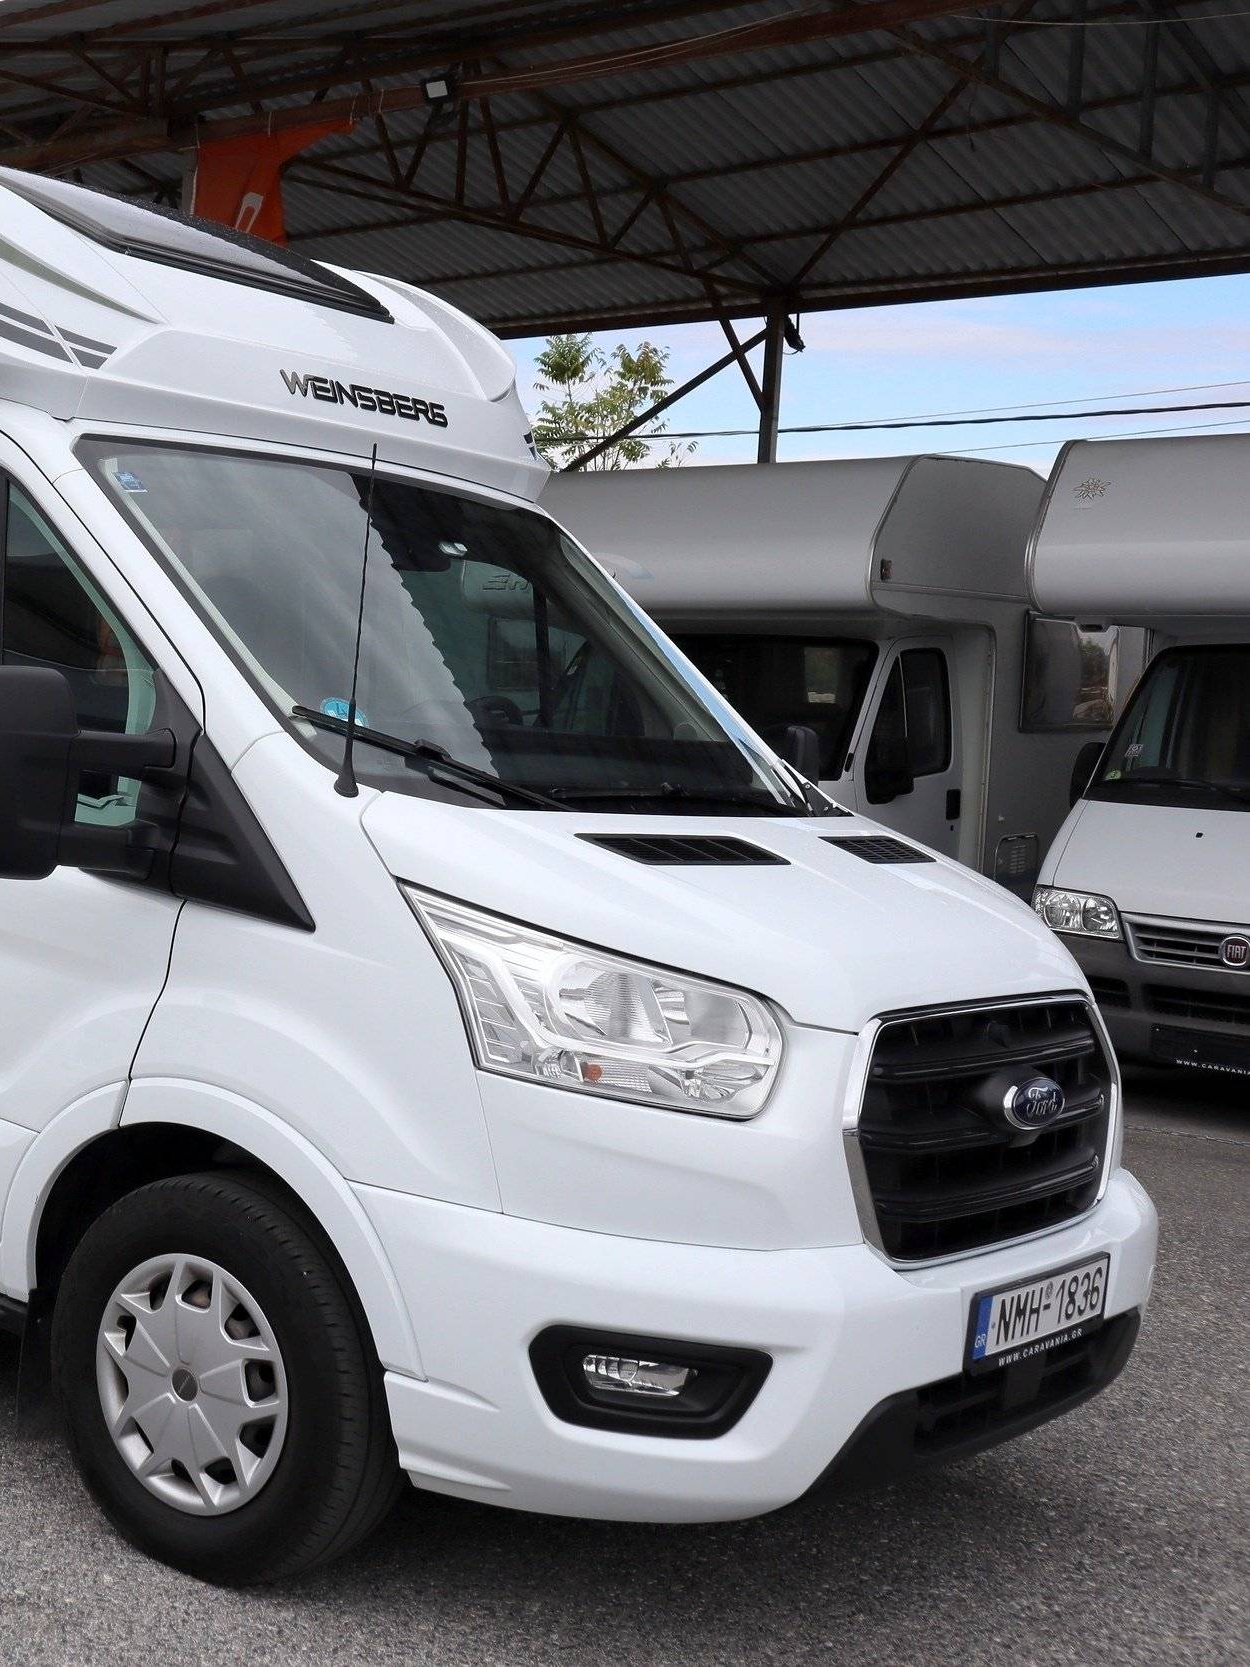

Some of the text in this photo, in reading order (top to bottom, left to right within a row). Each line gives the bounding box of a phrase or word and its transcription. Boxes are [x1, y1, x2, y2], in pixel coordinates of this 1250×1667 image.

[279, 368, 449, 429] WEINSBERG
[1227, 944, 1247, 959] FIAT
[974, 1266, 1103, 1349] GR NMH-1836
[998, 1328, 1083, 1367] WWW.CARAVANIA.GR
